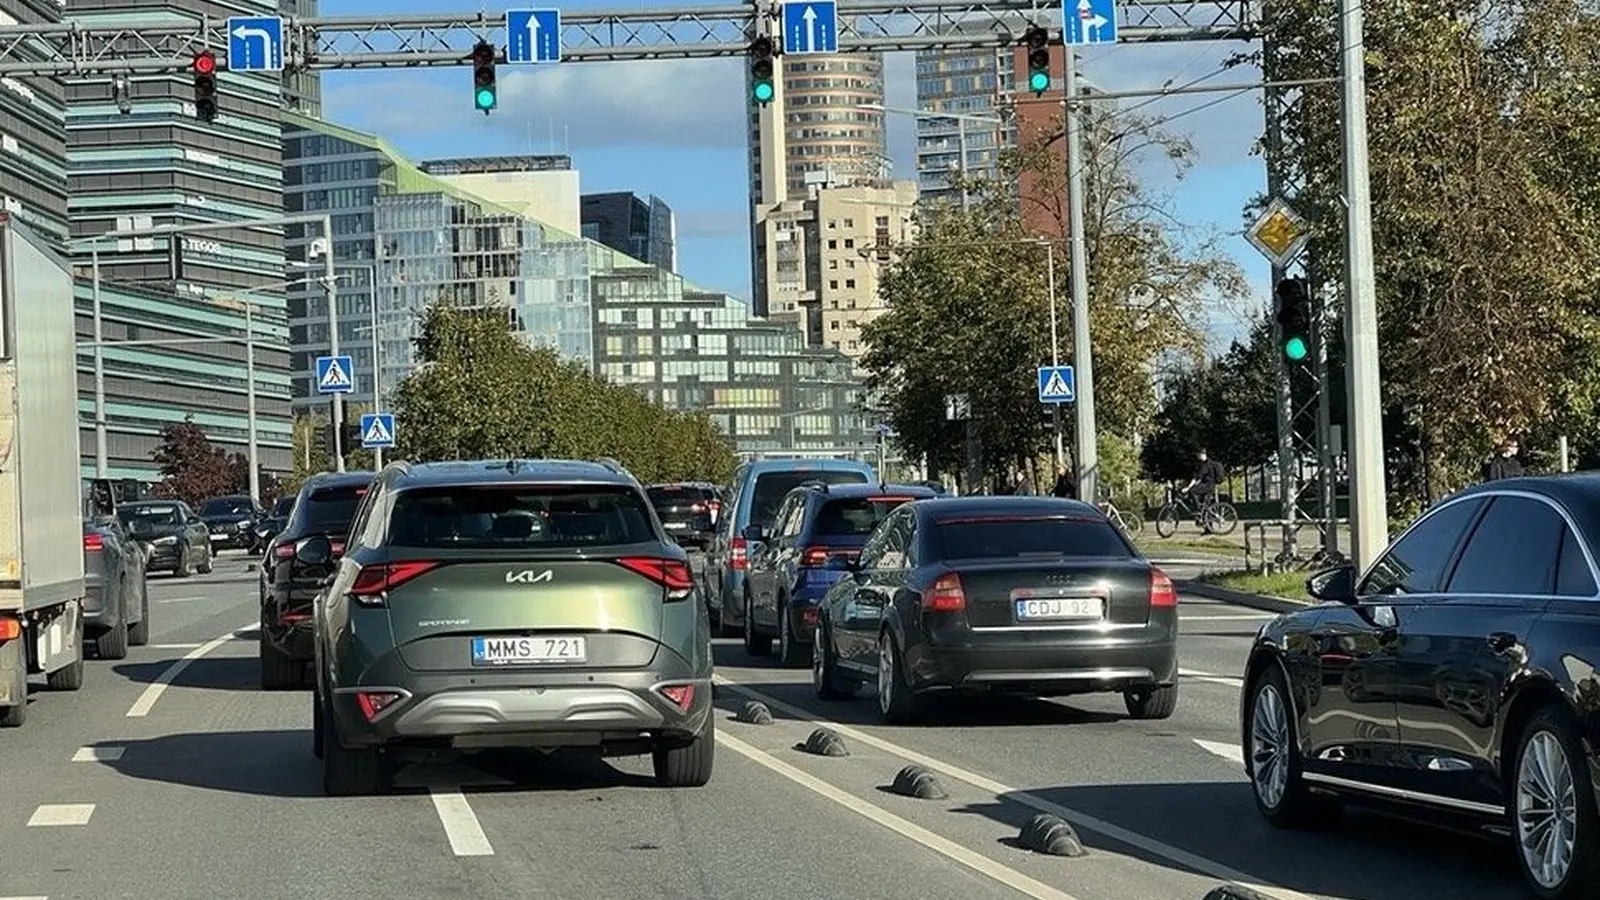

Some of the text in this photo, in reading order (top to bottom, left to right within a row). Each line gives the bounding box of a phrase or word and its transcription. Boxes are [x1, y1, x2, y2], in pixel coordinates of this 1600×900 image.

[506, 570, 553, 583] KIA
[1028, 600, 1096, 616] CDJ 92
[488, 639, 580, 658] MMS 721
